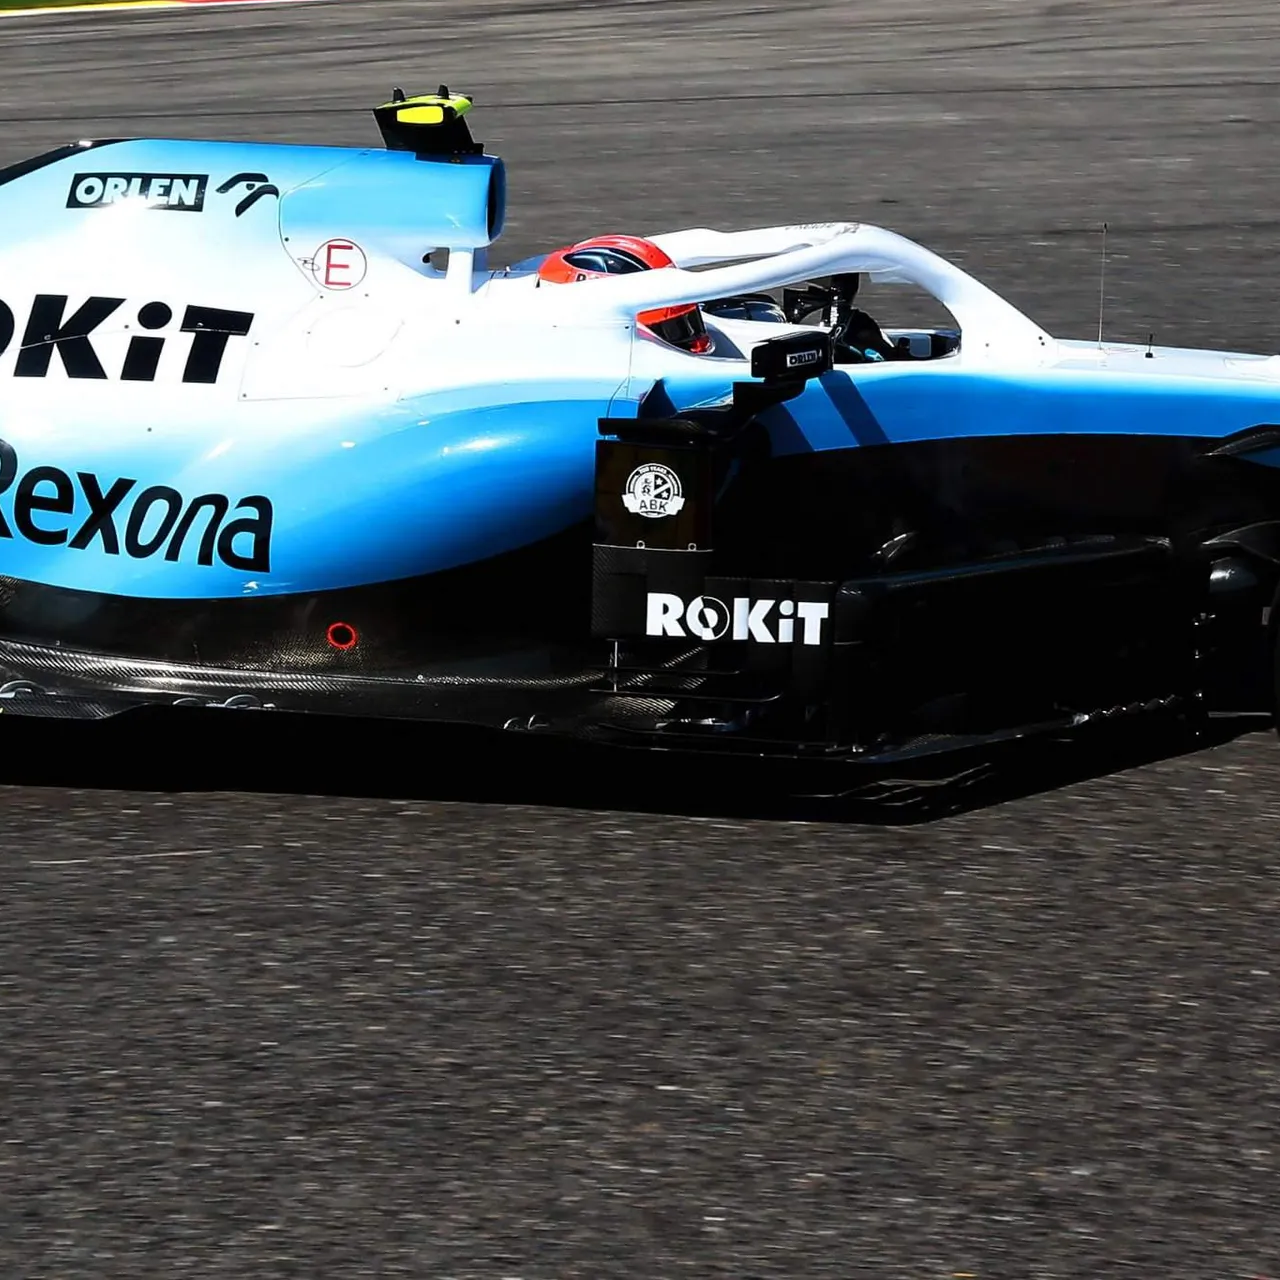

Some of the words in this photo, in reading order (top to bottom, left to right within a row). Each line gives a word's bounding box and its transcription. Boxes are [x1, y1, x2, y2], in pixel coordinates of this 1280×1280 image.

[74, 175, 200, 207] ORLEN
[324, 244, 353, 286] E
[639, 499, 669, 513] ABK
